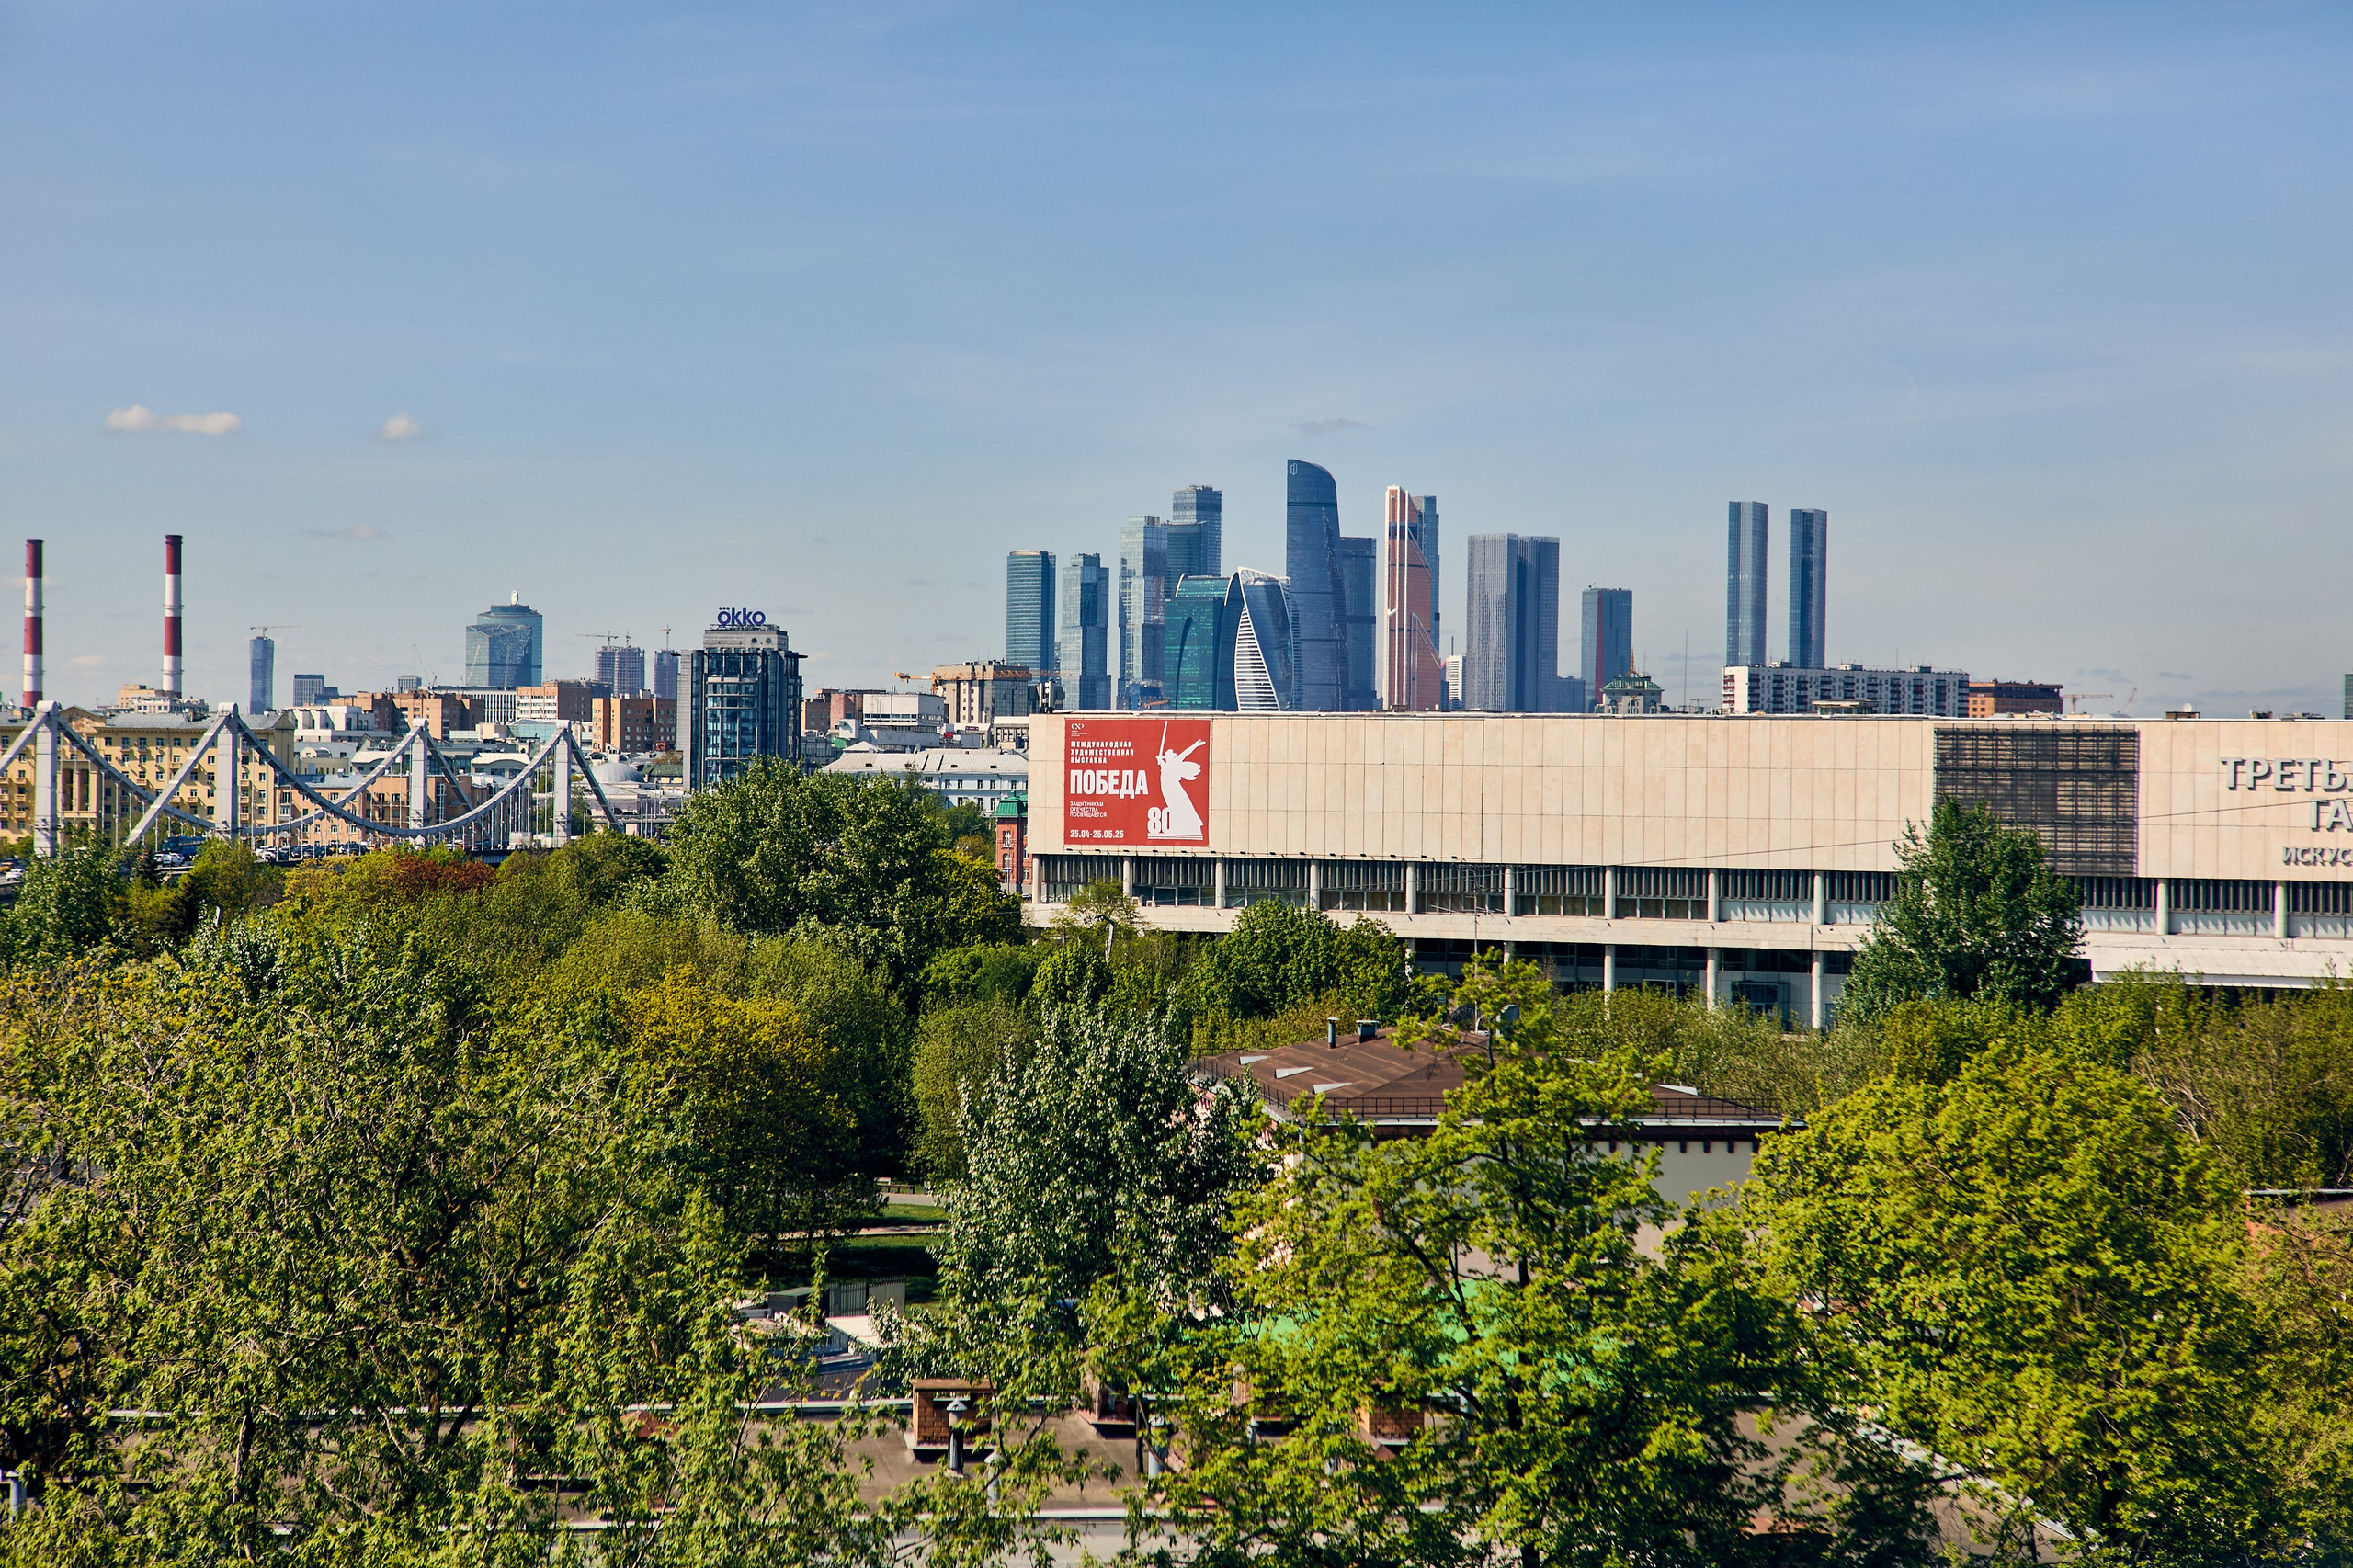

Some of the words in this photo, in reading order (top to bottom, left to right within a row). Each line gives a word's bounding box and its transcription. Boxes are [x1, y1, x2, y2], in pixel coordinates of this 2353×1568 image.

[1070, 770, 1148, 799] ПОБЕДА
[2221, 758, 2353, 792] ТРЕТЬ
[1070, 830, 1124, 838] 25.04-25.05.25
[1148, 807, 1171, 834] 80
[2282, 846, 2353, 867] ИСКУС
